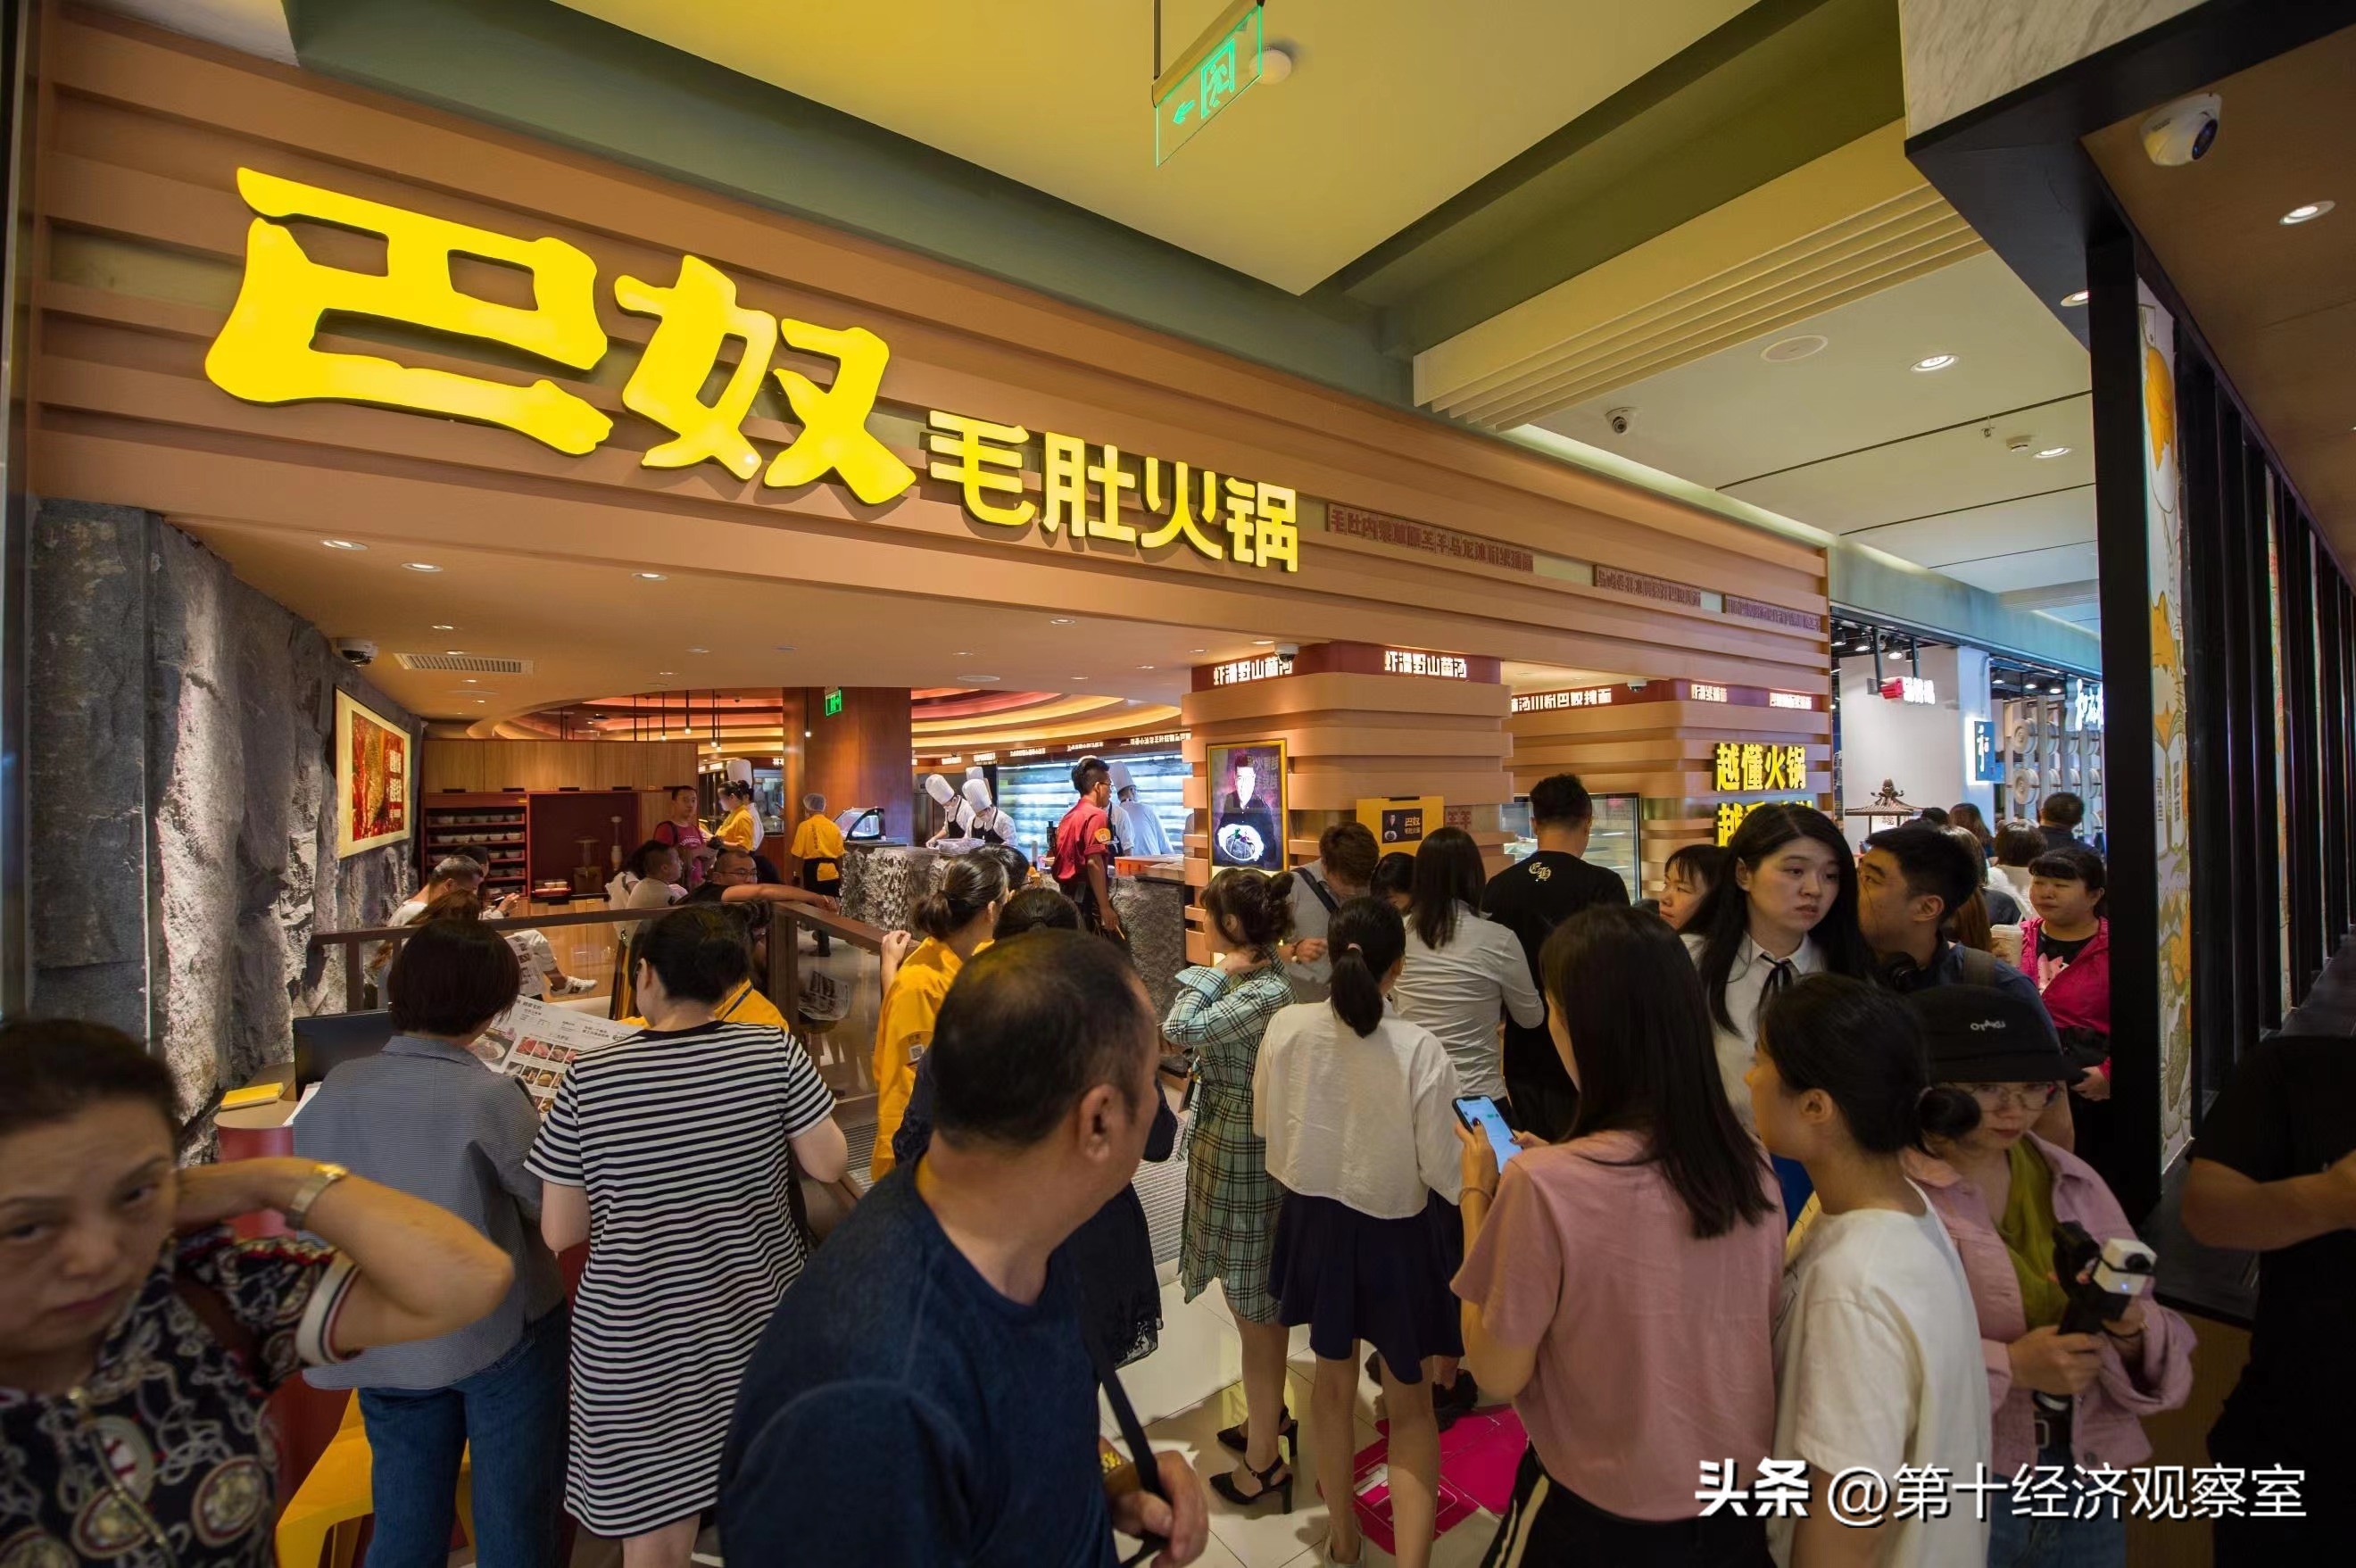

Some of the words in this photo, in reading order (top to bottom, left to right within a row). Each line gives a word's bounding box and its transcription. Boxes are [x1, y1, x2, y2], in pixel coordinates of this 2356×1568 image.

[203, 167, 917, 505] 巴奴
[929, 410, 1298, 573] 毛肚火锅
[1717, 743, 1806, 792] 越懂火锅
